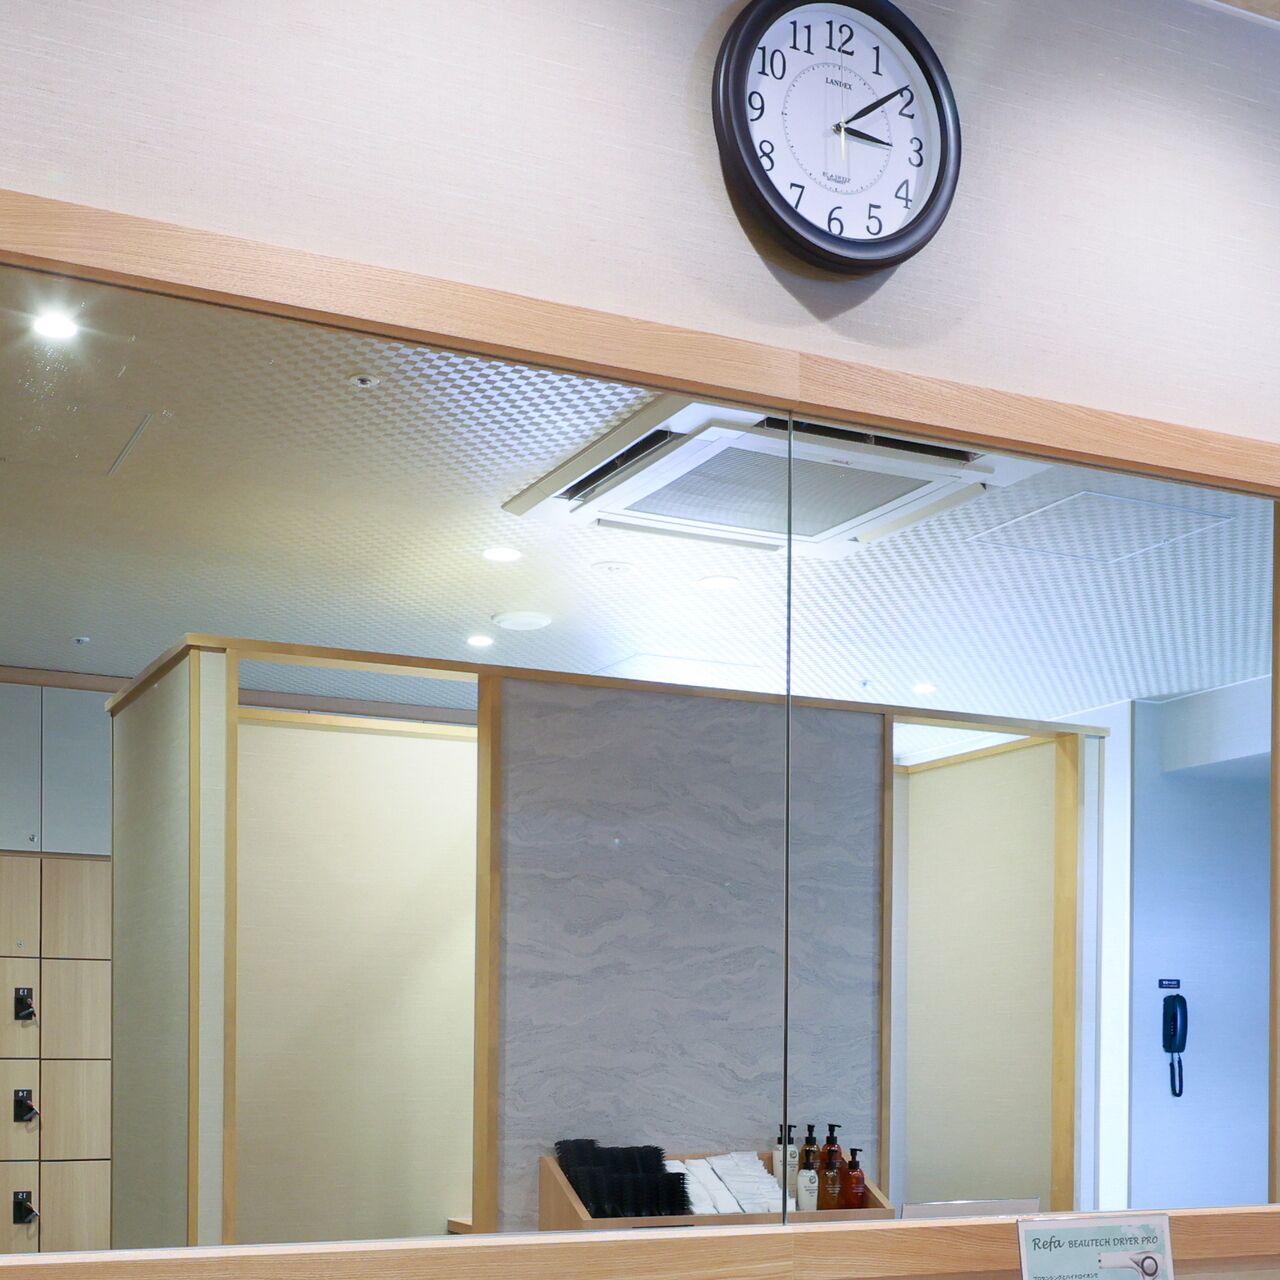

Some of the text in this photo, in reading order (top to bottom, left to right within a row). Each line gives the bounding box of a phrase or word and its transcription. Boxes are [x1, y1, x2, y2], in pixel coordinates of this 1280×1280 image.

[789, 20, 815, 55] 11
[825, 20, 855, 56] 12
[757, 46, 787, 80] 10
[872, 45, 883, 76] 1
[748, 91, 765, 122] 9
[898, 88, 915, 119] 2
[758, 139, 776, 172] 8
[908, 137, 924, 168] 3
[789, 182, 806, 211] 7
[894, 179, 913, 210] 4
[827, 205, 844, 236] 6
[865, 203, 883, 236] 5
[1068, 1238, 1111, 1249] BEAUTECH
[1113, 1237, 1139, 1246] DRYER
[1141, 1235, 1158, 1245] PRO
